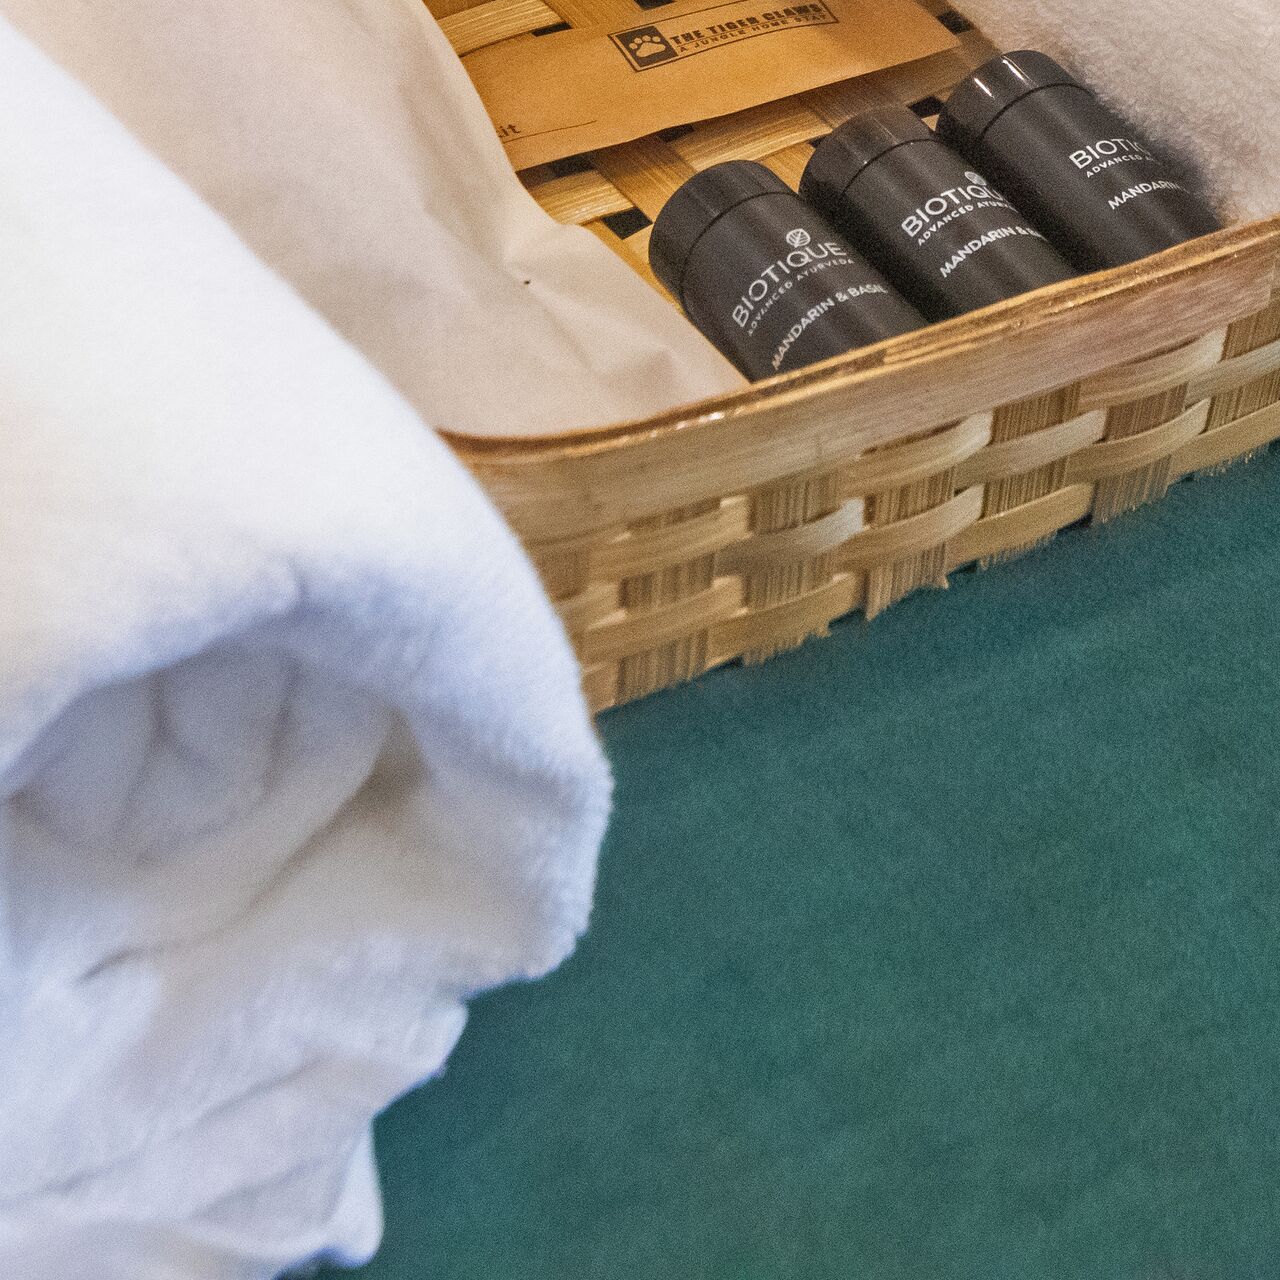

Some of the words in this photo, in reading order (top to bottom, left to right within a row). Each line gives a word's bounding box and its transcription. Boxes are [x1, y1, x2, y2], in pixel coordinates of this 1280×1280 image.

[670, 30, 705, 45] THE
[706, 17, 760, 34] TIGER
[762, 3, 823, 21] CLAWS
[1086, 154, 1143, 178] ADVANCED
[917, 204, 975, 246] ADVANCED
[939, 226, 1016, 278] MANDARIN
[731, 241, 848, 329] BIOTIQUE
[747, 281, 794, 336] ADVANCED
[796, 258, 855, 281] AYURVEDA
[771, 297, 836, 370] MANDARIN
[835, 290, 850, 302] &
[847, 283, 889, 298] BASIL
